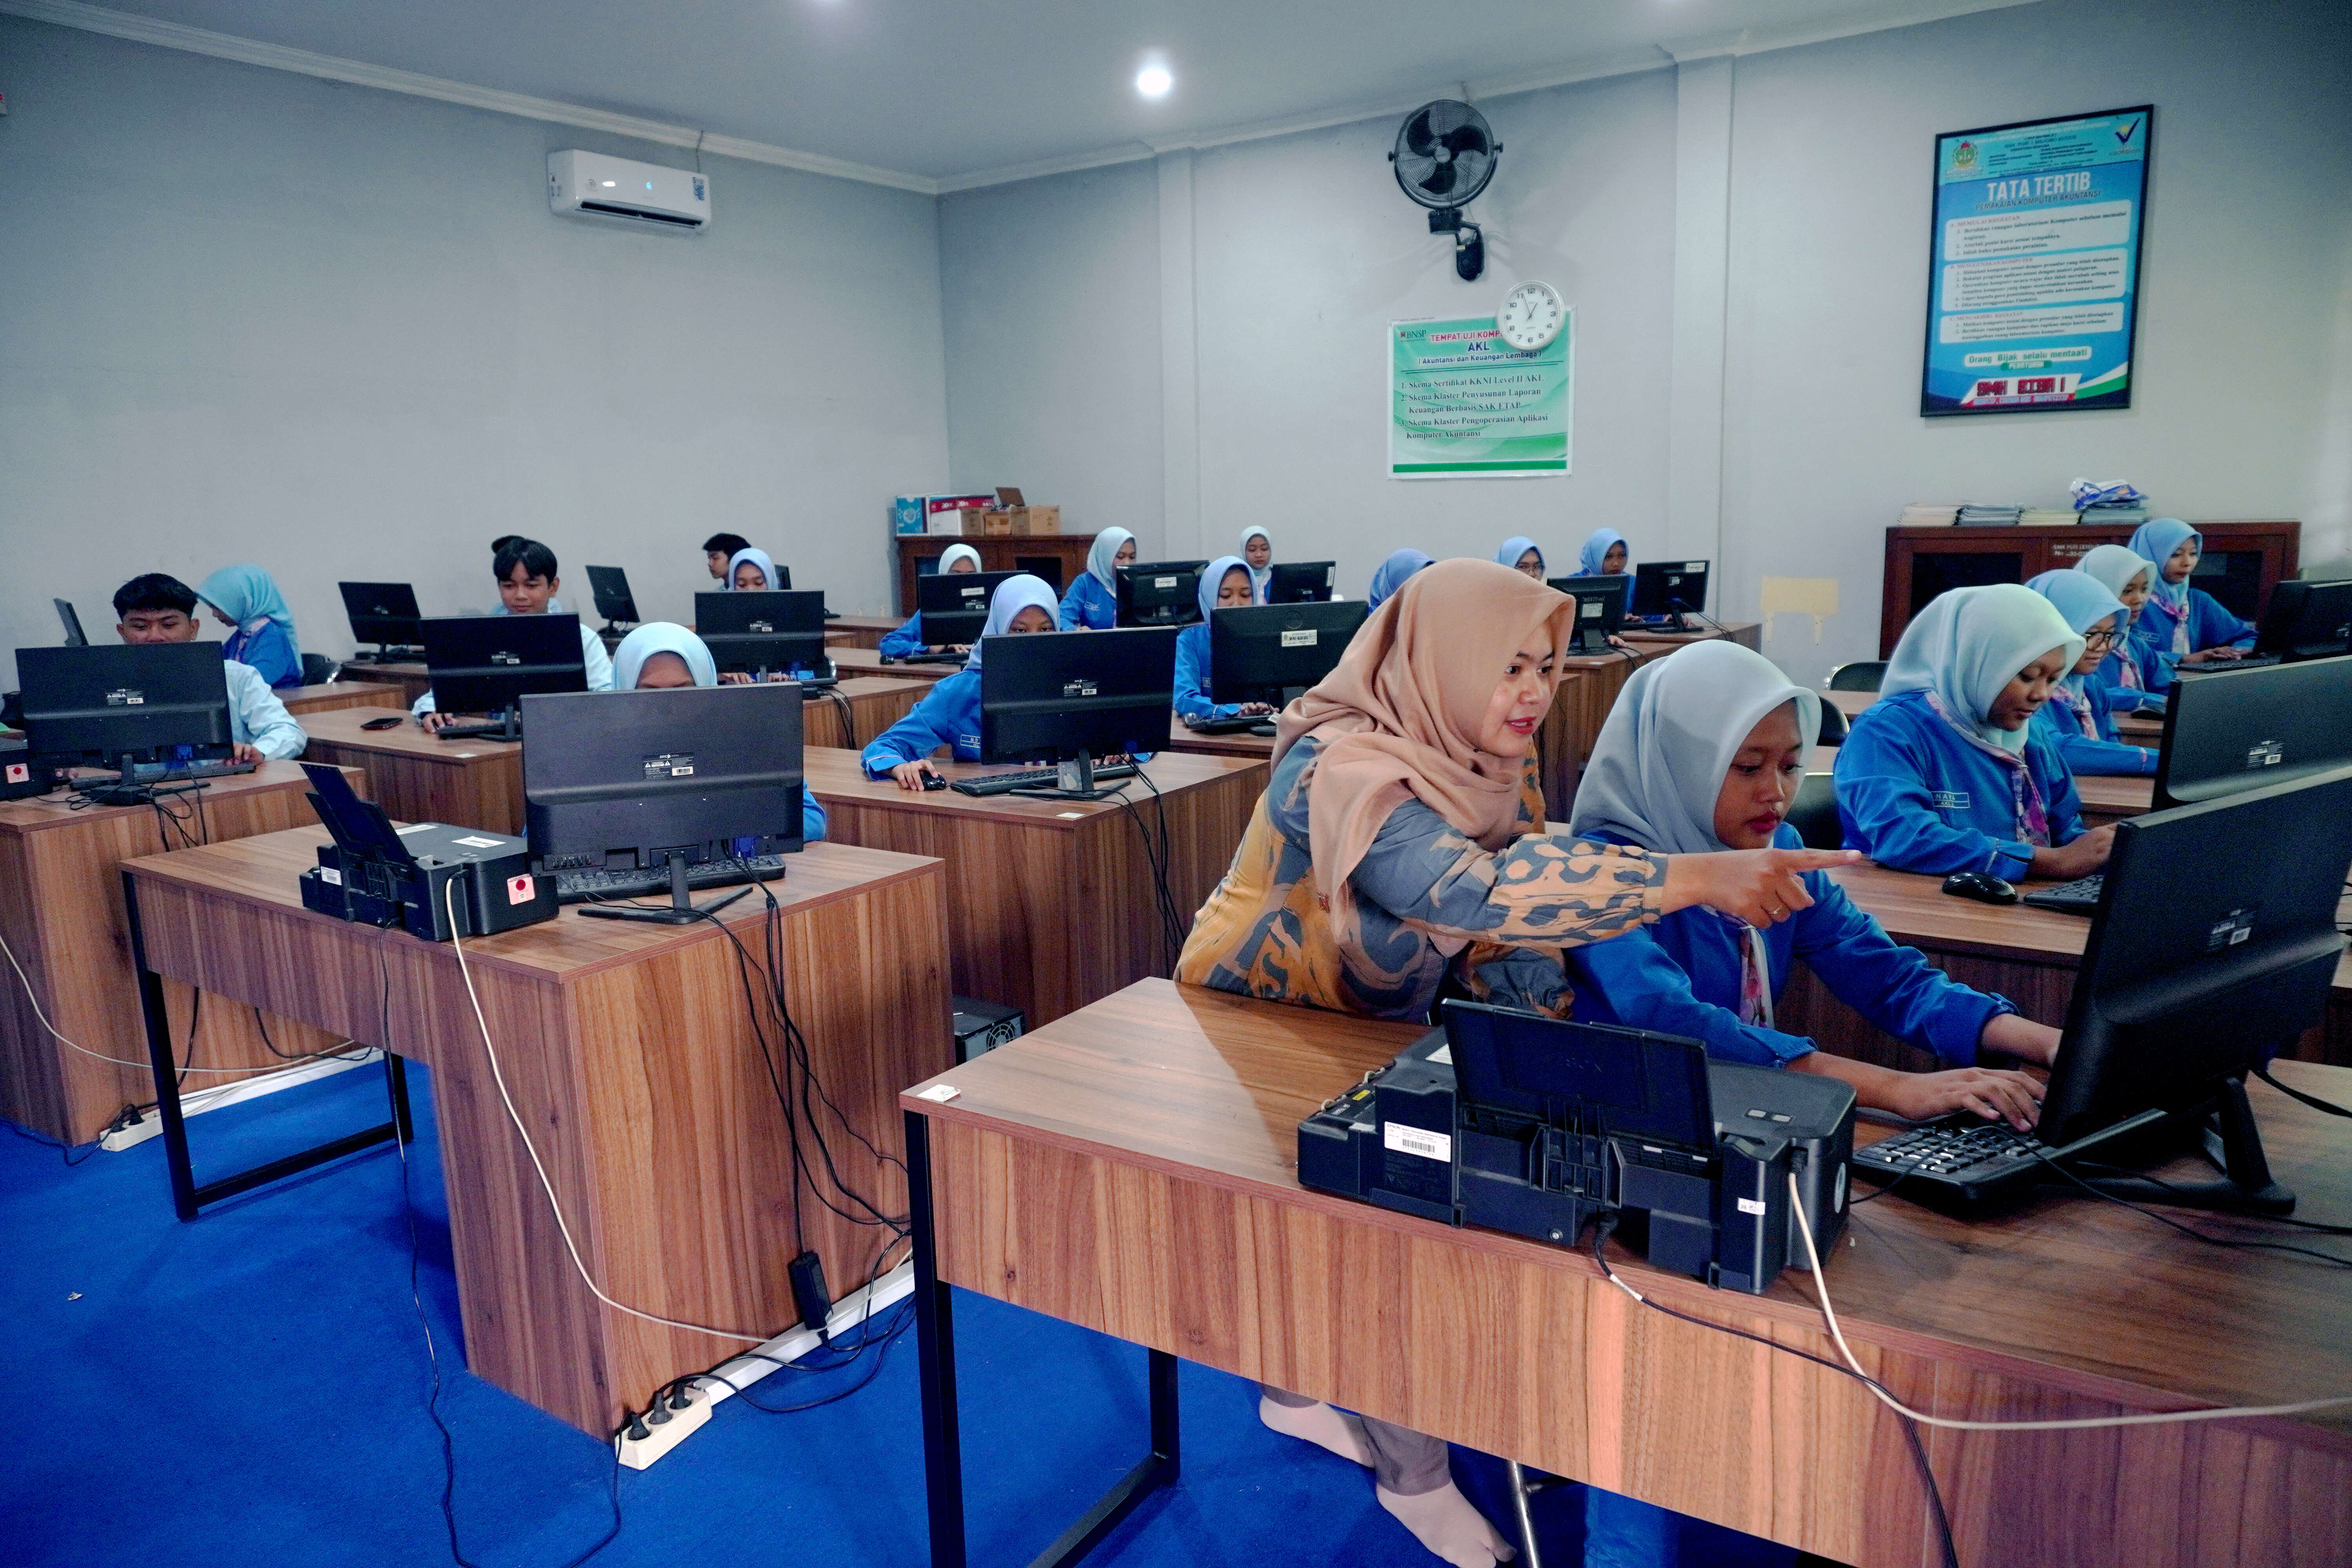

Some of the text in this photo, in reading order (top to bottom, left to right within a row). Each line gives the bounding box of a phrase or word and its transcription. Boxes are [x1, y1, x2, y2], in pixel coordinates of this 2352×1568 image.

[1987, 171, 2091, 202] TATA TERTIB
[1976, 200, 2016, 210] PEMAKAIAN
[2018, 195, 2058, 205] KOMPUTER
[1407, 330, 1426, 338] BNSP
[1431, 333, 1462, 342] TEMPAT
[1468, 341, 1490, 352] AKL
[1471, 353, 1504, 361] Keuangan
[1969, 348, 2087, 363] Orang Bijak selalu mentaati
[1470, 377, 1492, 385] KKNI
[1462, 391, 1506, 399] Penyusunan
[1462, 416, 1515, 425] Pengoperasian
[1517, 414, 1548, 423] Aplikasi
